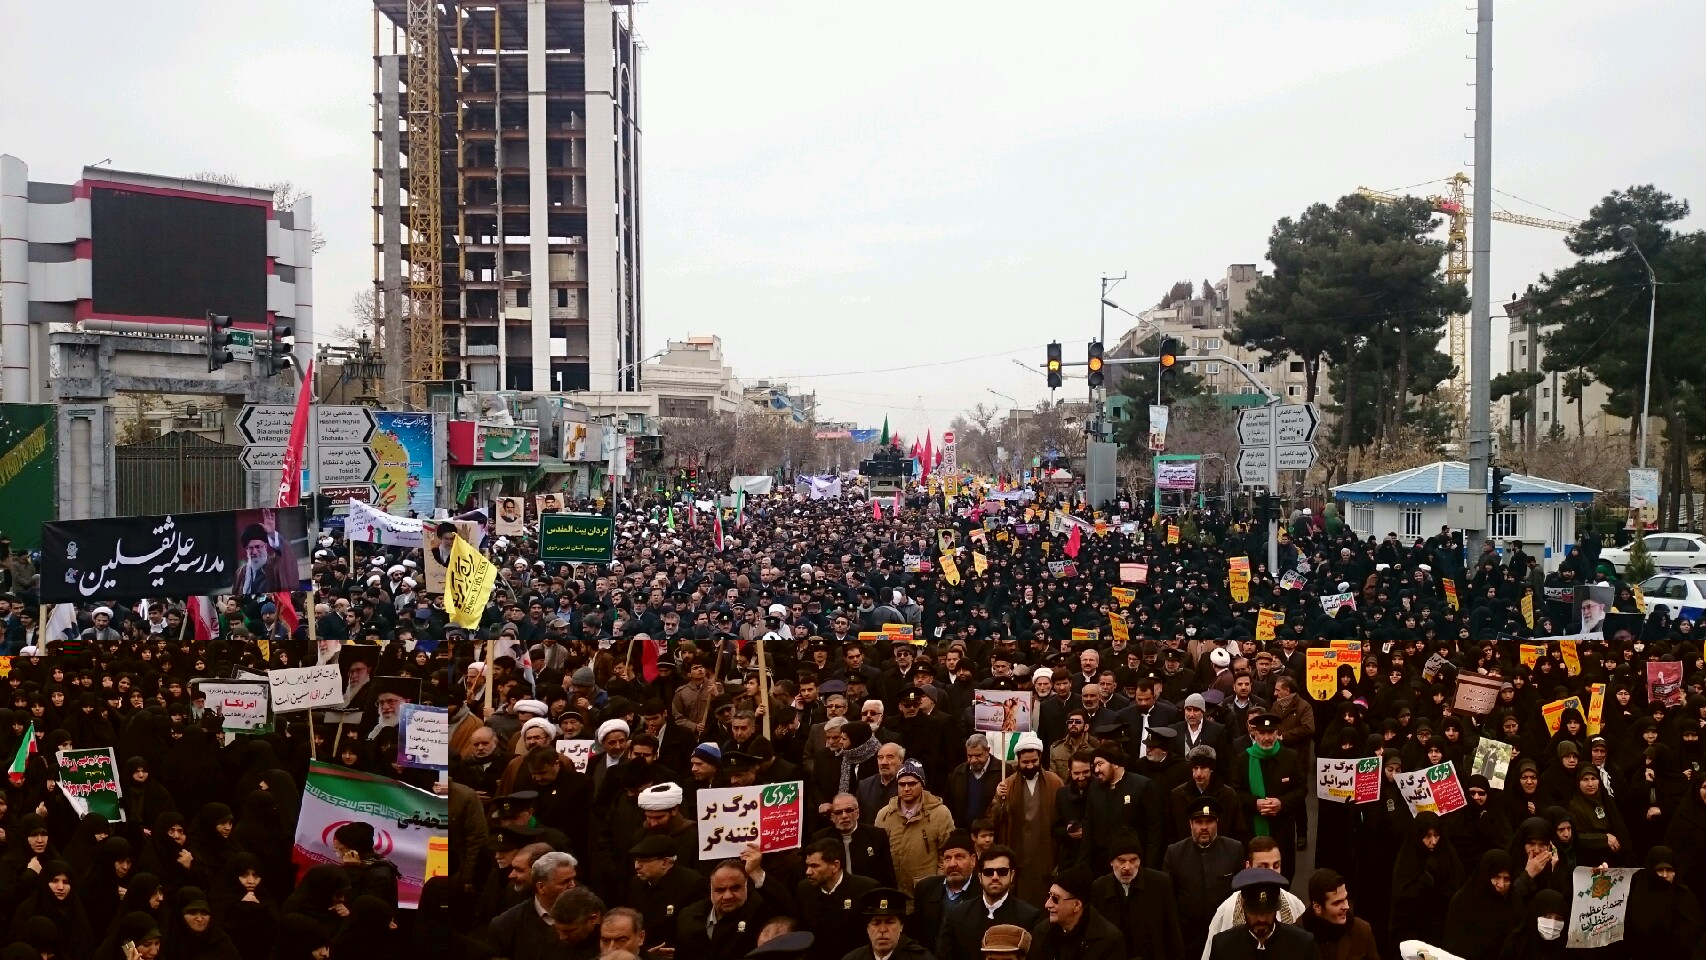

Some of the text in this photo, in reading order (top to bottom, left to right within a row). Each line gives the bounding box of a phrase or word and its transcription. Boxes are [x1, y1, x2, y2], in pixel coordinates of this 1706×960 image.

[546, 525, 609, 537] گردان بیت المقدس
[79, 515, 224, 597] مدرسه علمیه ثقلین
[1308, 660, 1338, 670] مطیع امر
[1312, 674, 1334, 683] رهبریم
[224, 699, 257, 711] امریکا
[568, 744, 589, 757] مرگ
[1321, 761, 1354, 773] مرگ بر
[1320, 775, 1353, 788] اسرائیل
[1406, 774, 1426, 788] مرگ
[1406, 788, 1432, 804] انگلیس
[701, 802, 718, 820] بر
[723, 795, 758, 817] مرگ
[703, 822, 759, 851] فتنه گر
[1579, 893, 1625, 922] اجتماع عظیم
[1581, 915, 1615, 931] منتظران
